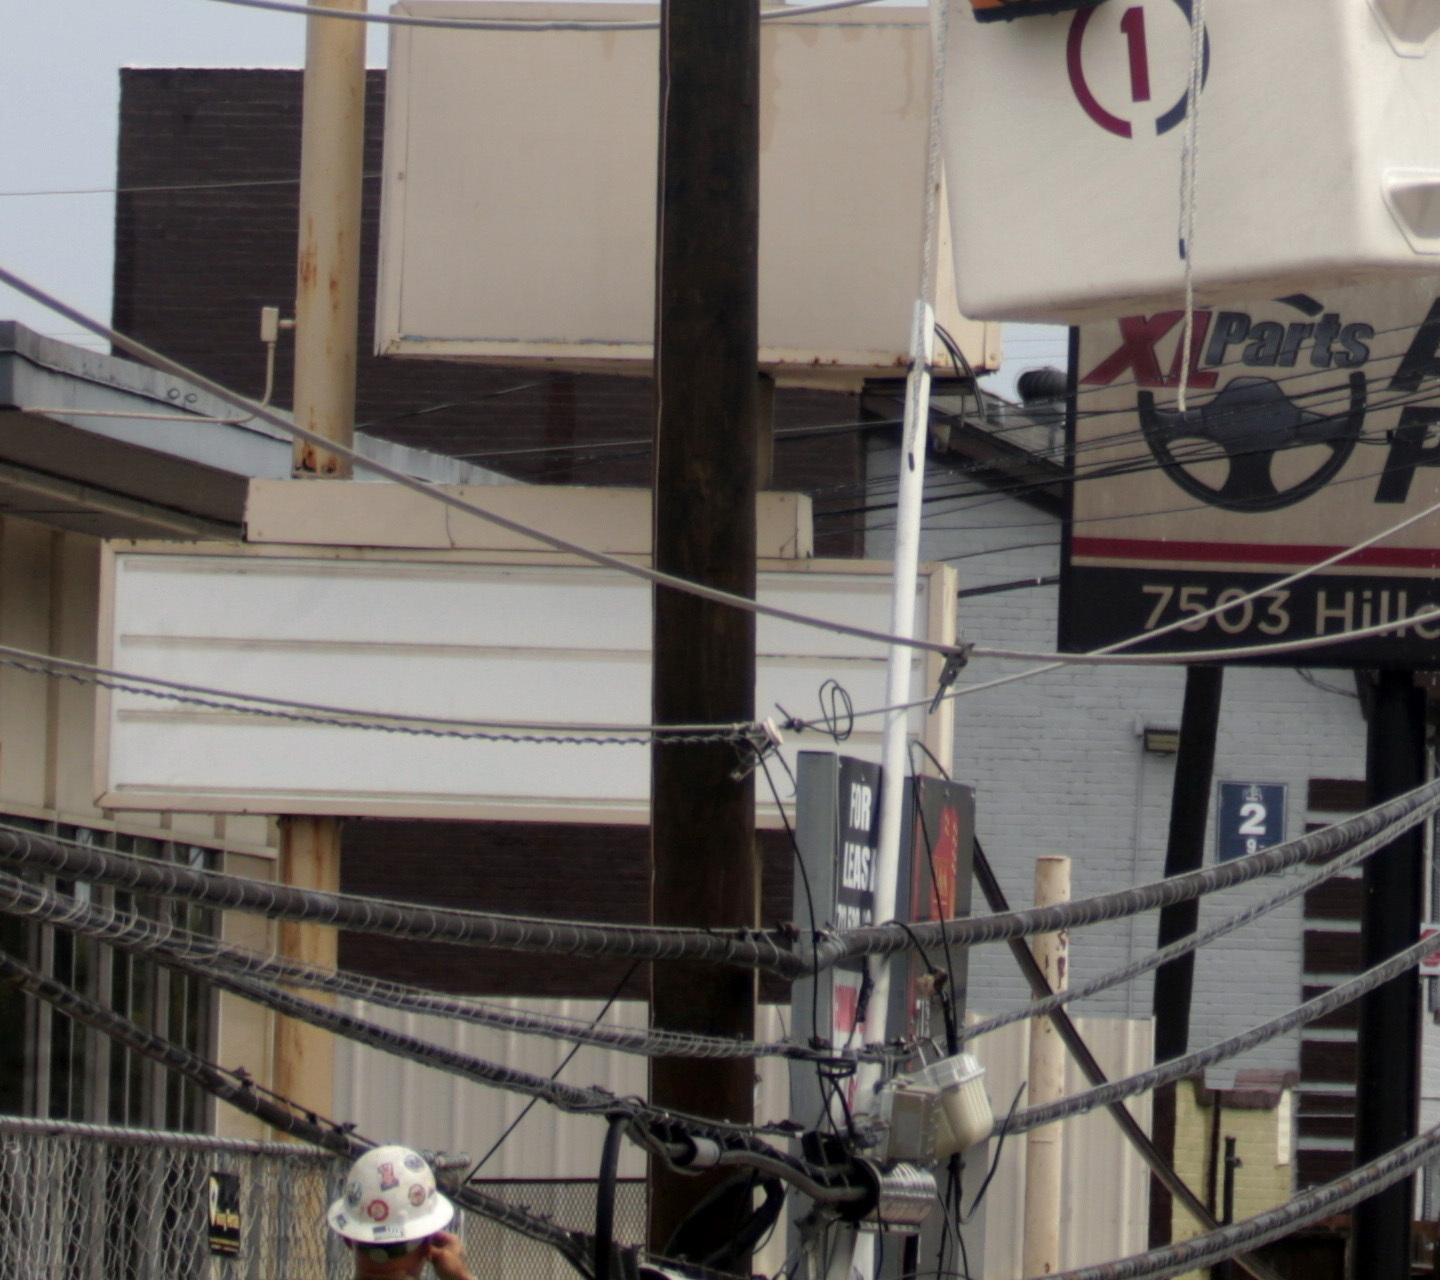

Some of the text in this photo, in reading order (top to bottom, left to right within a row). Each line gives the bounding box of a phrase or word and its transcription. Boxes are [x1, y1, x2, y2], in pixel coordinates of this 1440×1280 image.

[1141, 584, 1291, 637] 7503
[849, 782, 872, 832] FOR
[1238, 802, 1267, 835] 2
